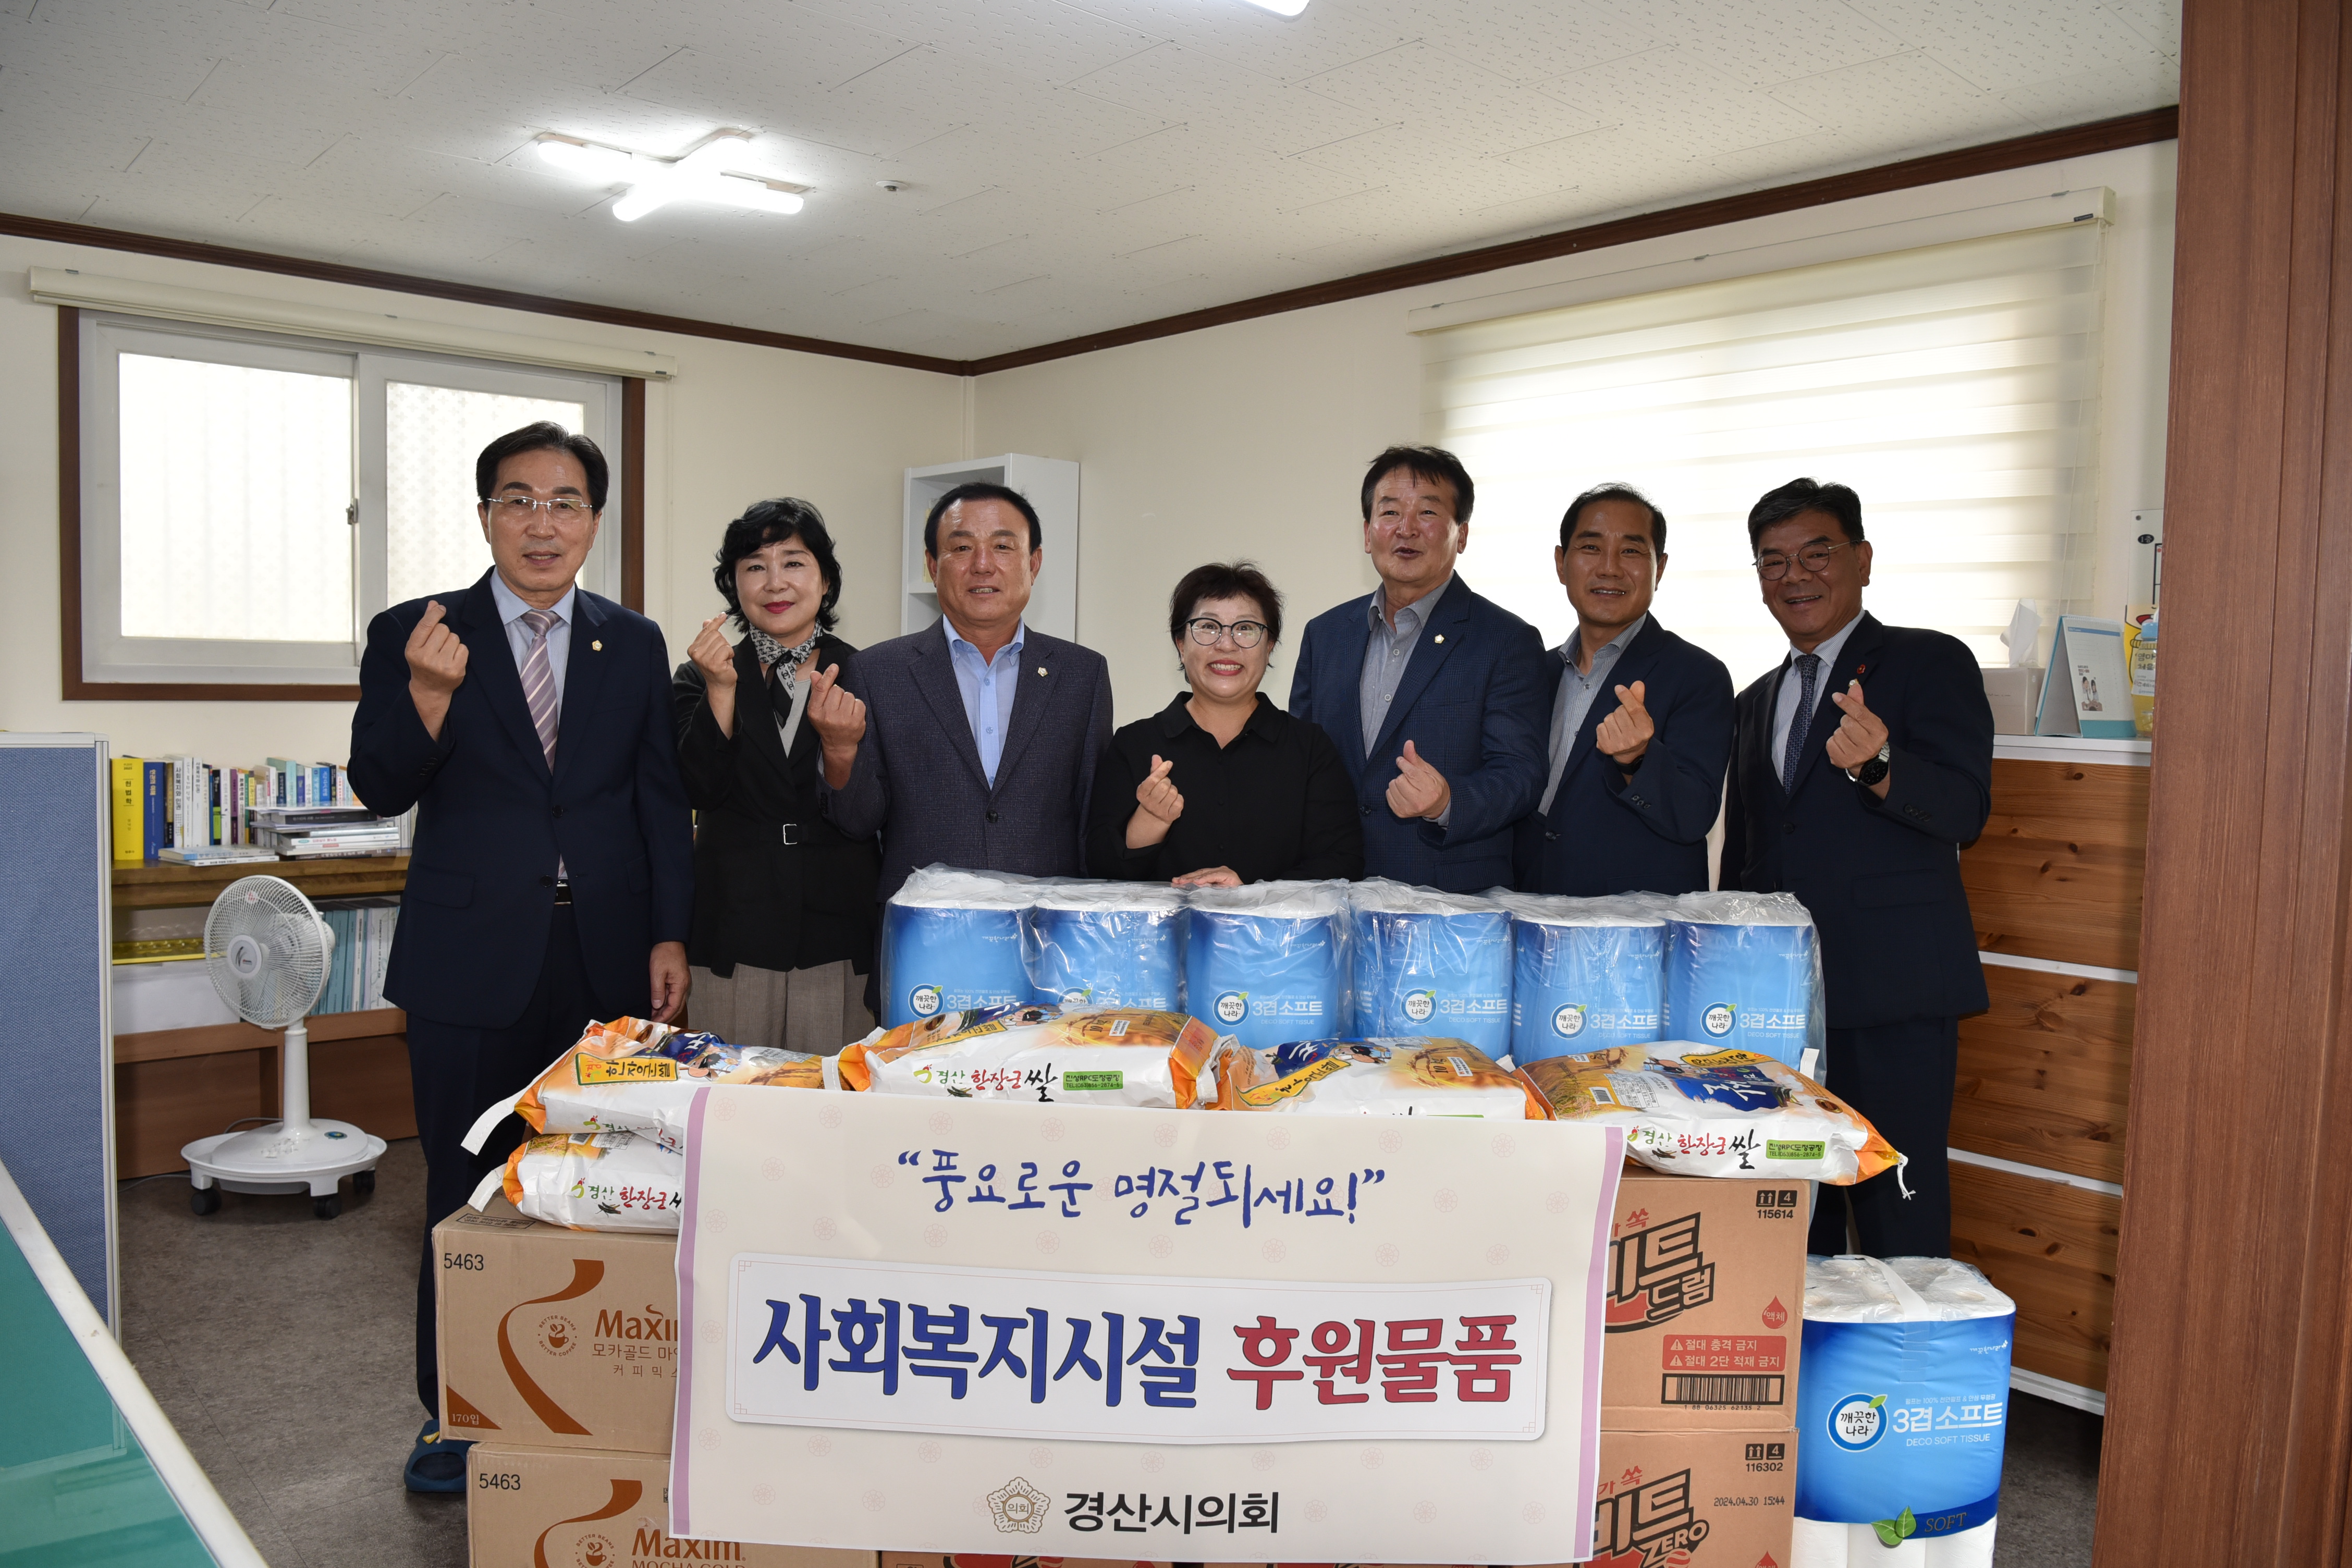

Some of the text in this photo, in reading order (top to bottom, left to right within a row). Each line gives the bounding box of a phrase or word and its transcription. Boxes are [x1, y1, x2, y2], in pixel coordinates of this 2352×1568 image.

[175, 798, 181, 811] 인권
[947, 995, 972, 1009] 3겹
[1220, 1001, 1243, 1010] 깨끗한
[1252, 1001, 1323, 1016] 3겹 소프트
[1440, 999, 1508, 1014] 3겹 소프트
[1559, 1014, 1581, 1023] 깨끗한
[1590, 1014, 1658, 1030] 3겹 소프트
[1740, 1013, 1806, 1030] 3겹 소프트
[937, 1063, 1058, 1102] 경산 한장군 쌀
[1643, 1129, 1761, 1170] 경산 한장군 쌀
[588, 1185, 615, 1201] 경산
[619, 1185, 667, 1210] 한장군
[1783, 1192, 1791, 1202] 4
[1757, 1209, 1794, 1219] 115614
[444, 1253, 484, 1271] 5463
[1648, 1263, 1714, 1318] 드럼
[538, 1315, 577, 1331] BETTER BEANS
[1767, 1311, 1785, 1322] 액체
[594, 1309, 678, 1341] Maxi
[538, 1340, 577, 1357] BETTER COFFEE
[592, 1343, 652, 1361] 모카골드
[753, 1293, 1522, 1411] 사회복지시설 후원물품
[1685, 1339, 1757, 1351] 절대 충격 금지
[1684, 1355, 1780, 1367] 절대 2단 적재 금지
[451, 1413, 480, 1425] 170입
[1841, 1411, 1876, 1424] 깨끗한
[1892, 1402, 2003, 1433] 3겹 소프트
[1846, 1425, 1868, 1437] 나라
[1906, 1434, 1991, 1447] DECO SOFT TISSUE
[1771, 1445, 1779, 1455] 4
[1746, 1462, 1783, 1472] 116302
[479, 1473, 521, 1490] 5463
[1621, 1465, 1643, 1487] 쏙
[1007, 1502, 1030, 1515] 의회
[1713, 1496, 1785, 1506] 2024.04.30 15:44
[1064, 1491, 1279, 1535] 경산시의회
[1924, 1512, 1967, 1533] SOFT
[576, 1534, 615, 1549] BETTER BEANS
